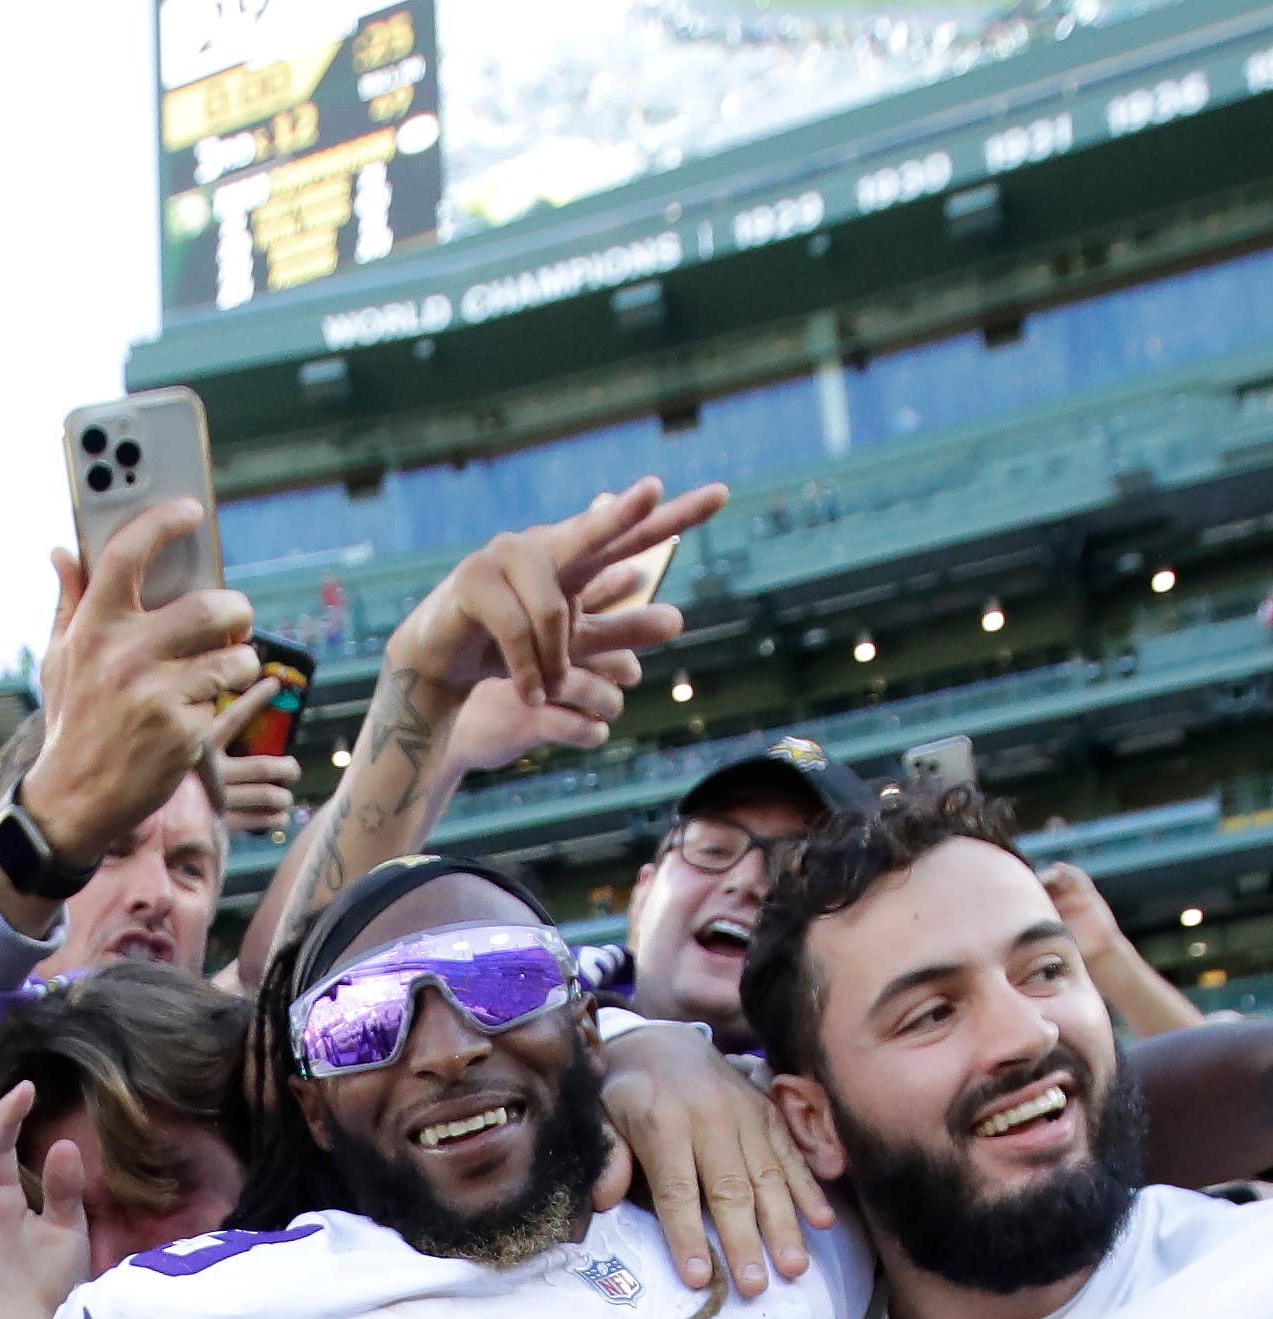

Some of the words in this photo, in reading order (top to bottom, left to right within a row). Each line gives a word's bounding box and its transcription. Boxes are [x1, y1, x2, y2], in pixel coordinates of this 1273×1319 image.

[322, 293, 454, 351] WORLD
[460, 231, 683, 324] CHAMPIONS
[598, 1274, 638, 1297] NFL
